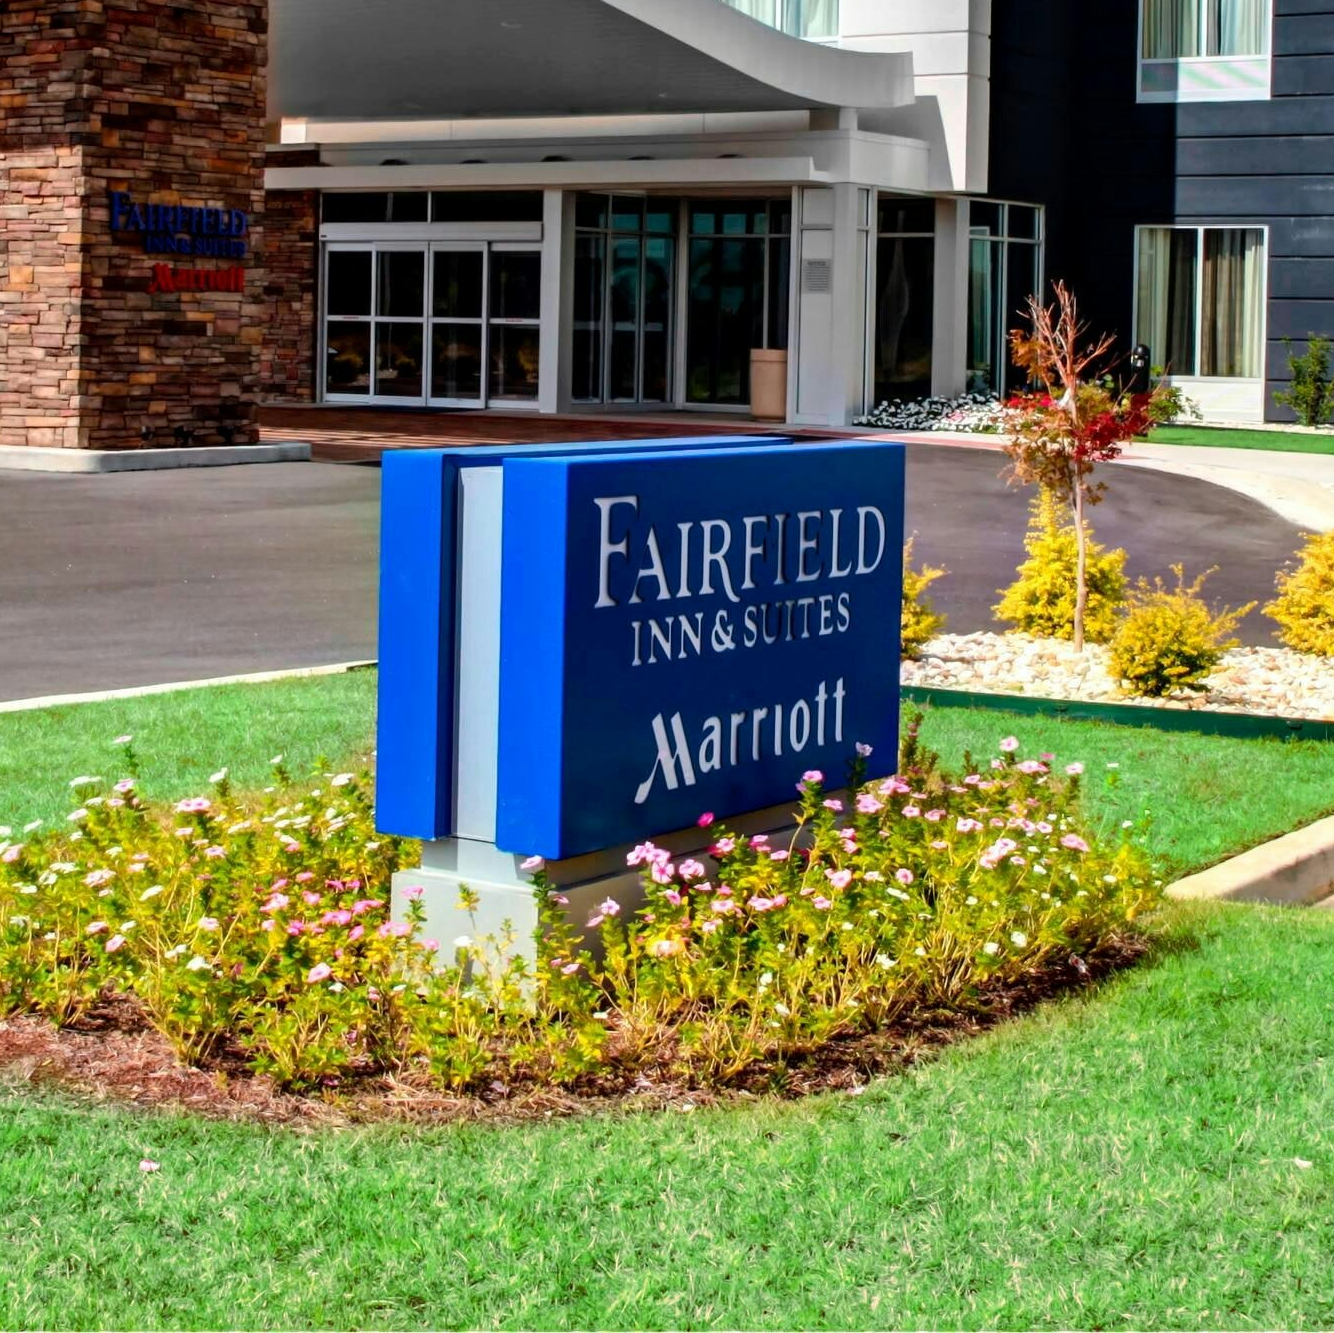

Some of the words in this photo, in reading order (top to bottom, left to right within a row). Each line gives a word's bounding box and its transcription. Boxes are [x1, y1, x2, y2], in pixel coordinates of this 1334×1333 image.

[108, 191, 247, 236] FAIRFIELD
[593, 494, 886, 609] FAIRFIELD
[631, 613, 704, 667] INN
[710, 609, 737, 653] &
[743, 592, 851, 649] SUITES
[633, 676, 847, 805] Marriott
